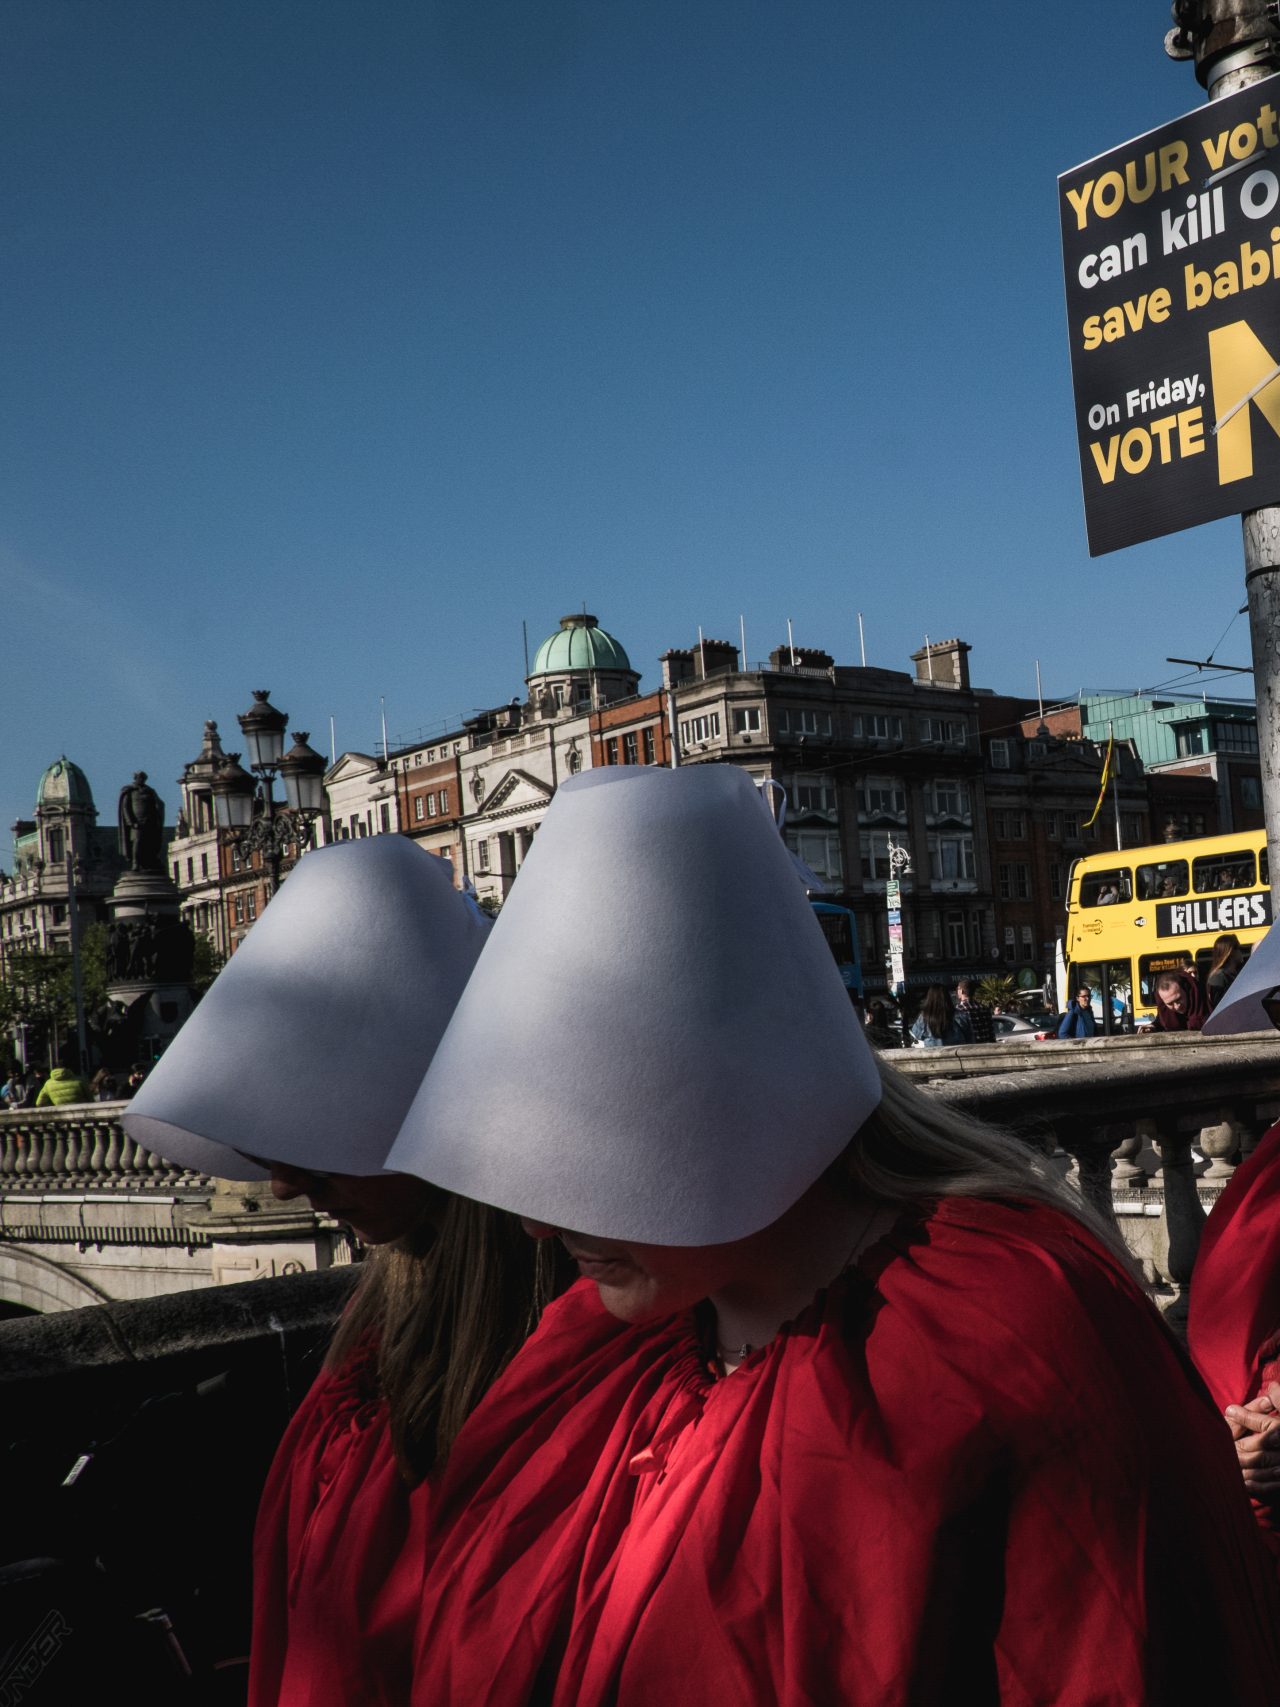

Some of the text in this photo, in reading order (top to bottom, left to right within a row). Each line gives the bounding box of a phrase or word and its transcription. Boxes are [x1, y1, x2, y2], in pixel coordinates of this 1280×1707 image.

[1066, 140, 1190, 231] YOUR
[1078, 230, 1148, 289] can
[1161, 187, 1226, 256] kill
[1082, 286, 1172, 351] save
[1088, 373, 1206, 431] On Friday,
[1090, 407, 1206, 485] VOTE
[1170, 894, 1266, 934] KILLERS
